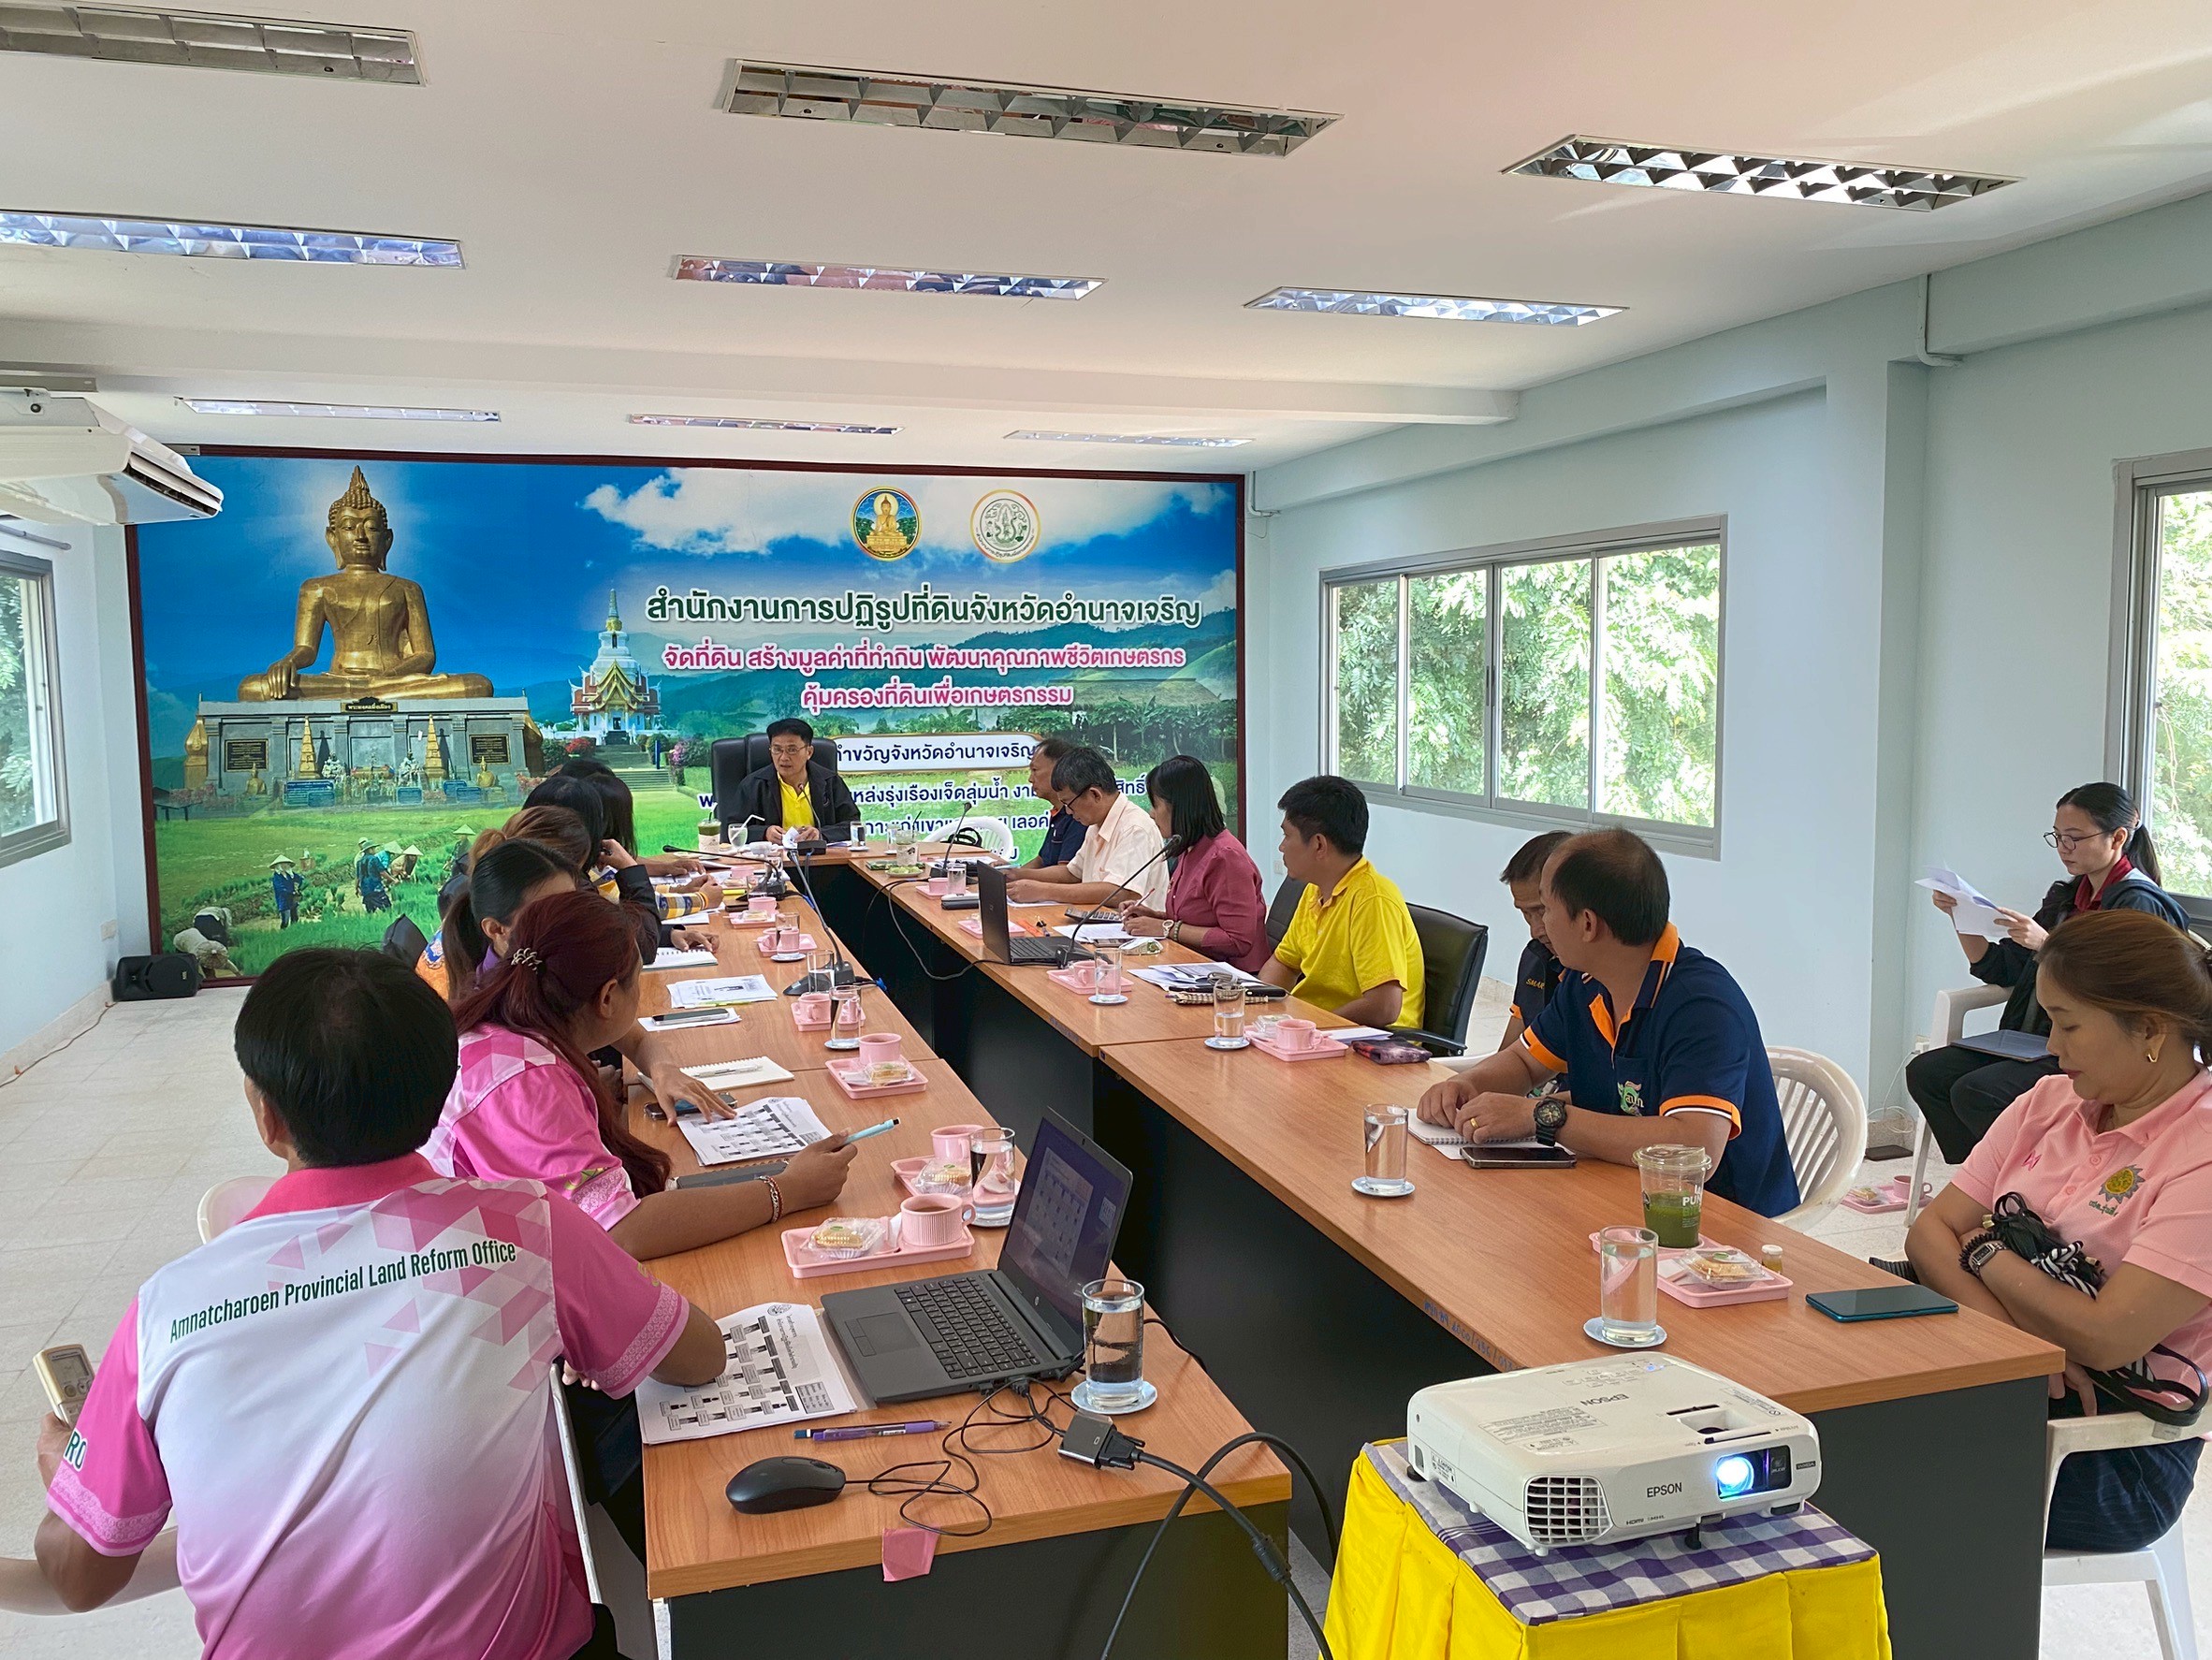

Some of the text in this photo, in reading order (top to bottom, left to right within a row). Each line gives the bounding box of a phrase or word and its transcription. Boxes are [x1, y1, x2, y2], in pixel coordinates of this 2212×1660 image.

[647, 585, 1201, 630] สำนักงานการปฏิรูปที่ดินจังหวัดอำนาจเจริญ
[664, 639, 1185, 674] จัดที่ดิน สร้างมูลค่าที่ทำกิน พัฒนาคุณภาพชีวิตเกษตรกร
[803, 678, 1071, 712] คุ้มครองที่ดินเพื่อเกษตรกรรม
[850, 778, 1009, 808] หล่งรุ่งเรืองเจ็ดลุ่มน้ำ
[169, 1239, 517, 1344] Amnatcharoen Provincial Land Reform Office
[1647, 1482, 1683, 1498] EPSON
